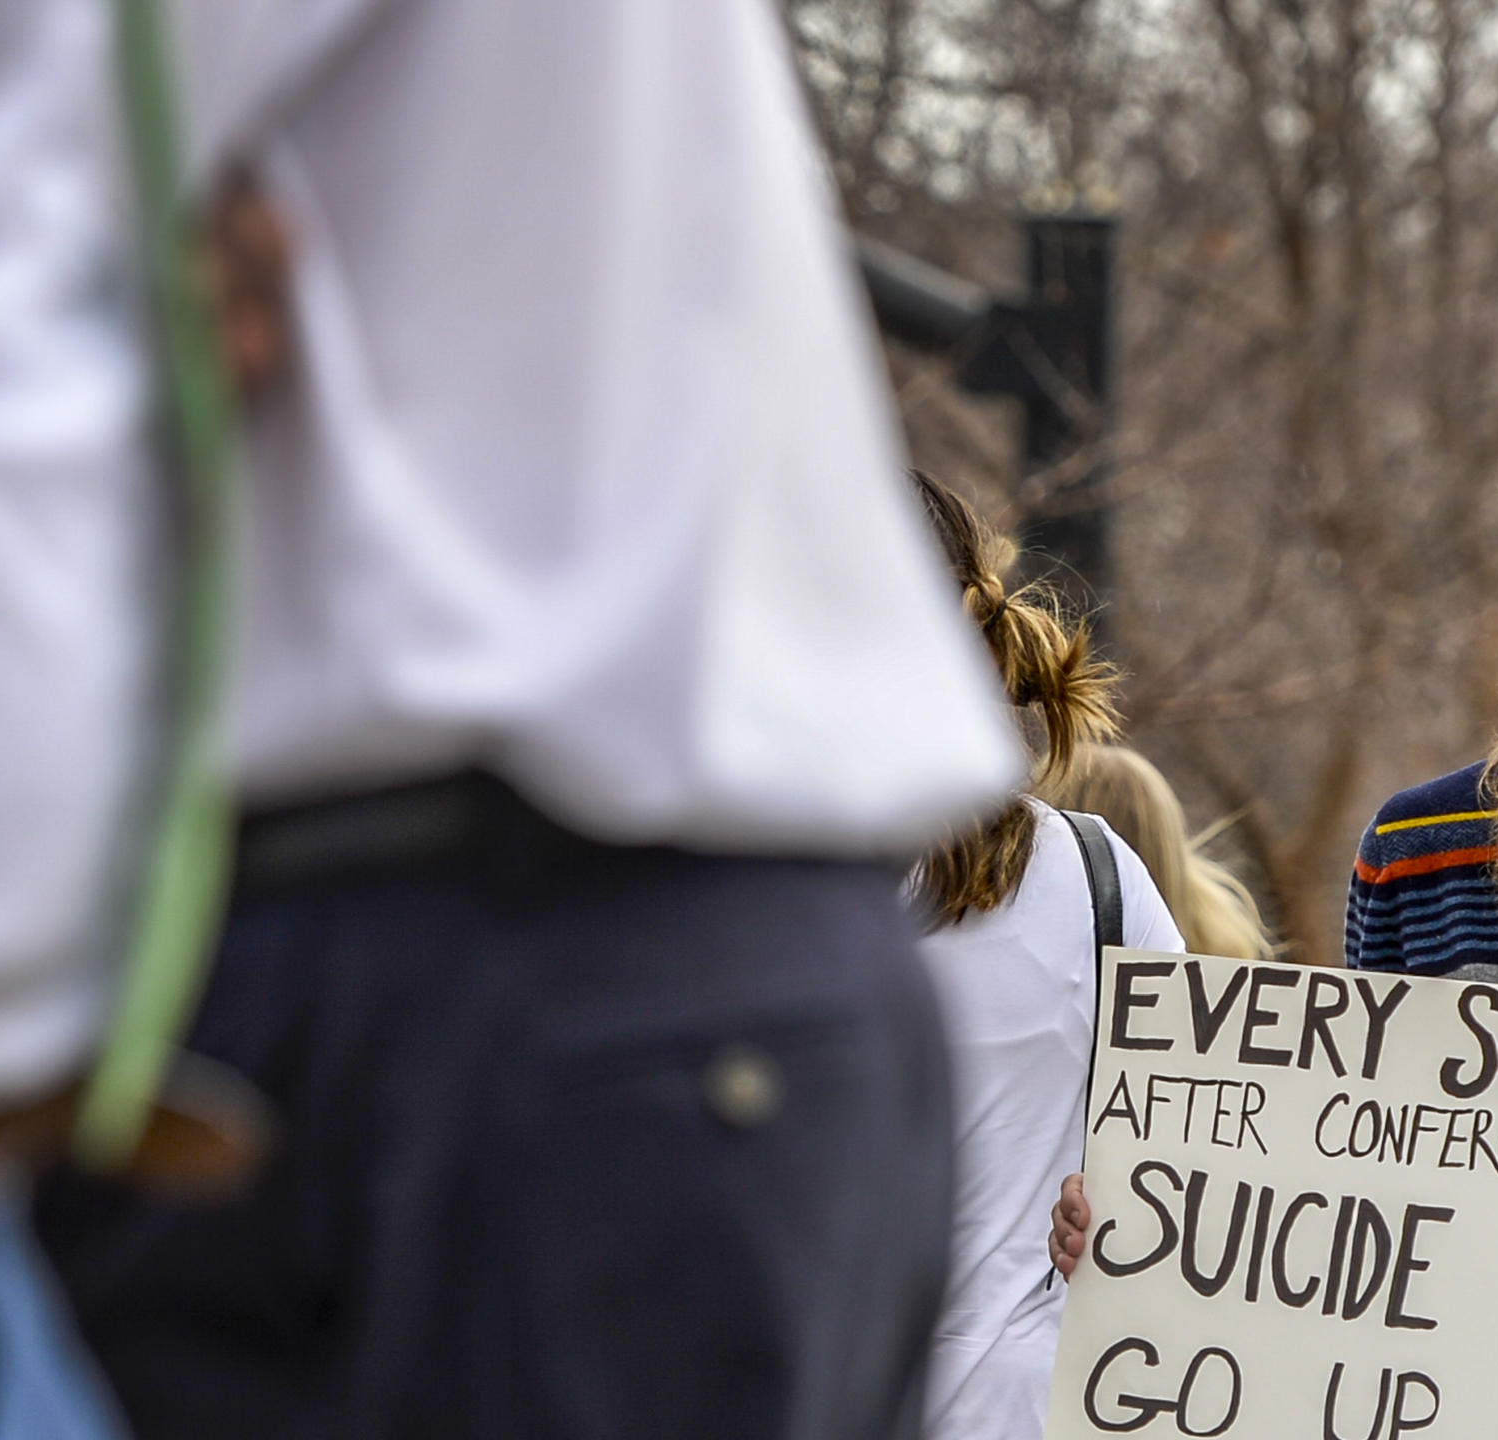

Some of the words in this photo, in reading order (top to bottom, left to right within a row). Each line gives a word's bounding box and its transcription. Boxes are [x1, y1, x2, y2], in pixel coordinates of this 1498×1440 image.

[1109, 960, 1412, 1080] EVERY
[1092, 1070, 1268, 1156] AFTER
[1091, 1160, 1456, 1330] SUICIDE
[1083, 1336, 1242, 1438] GO
